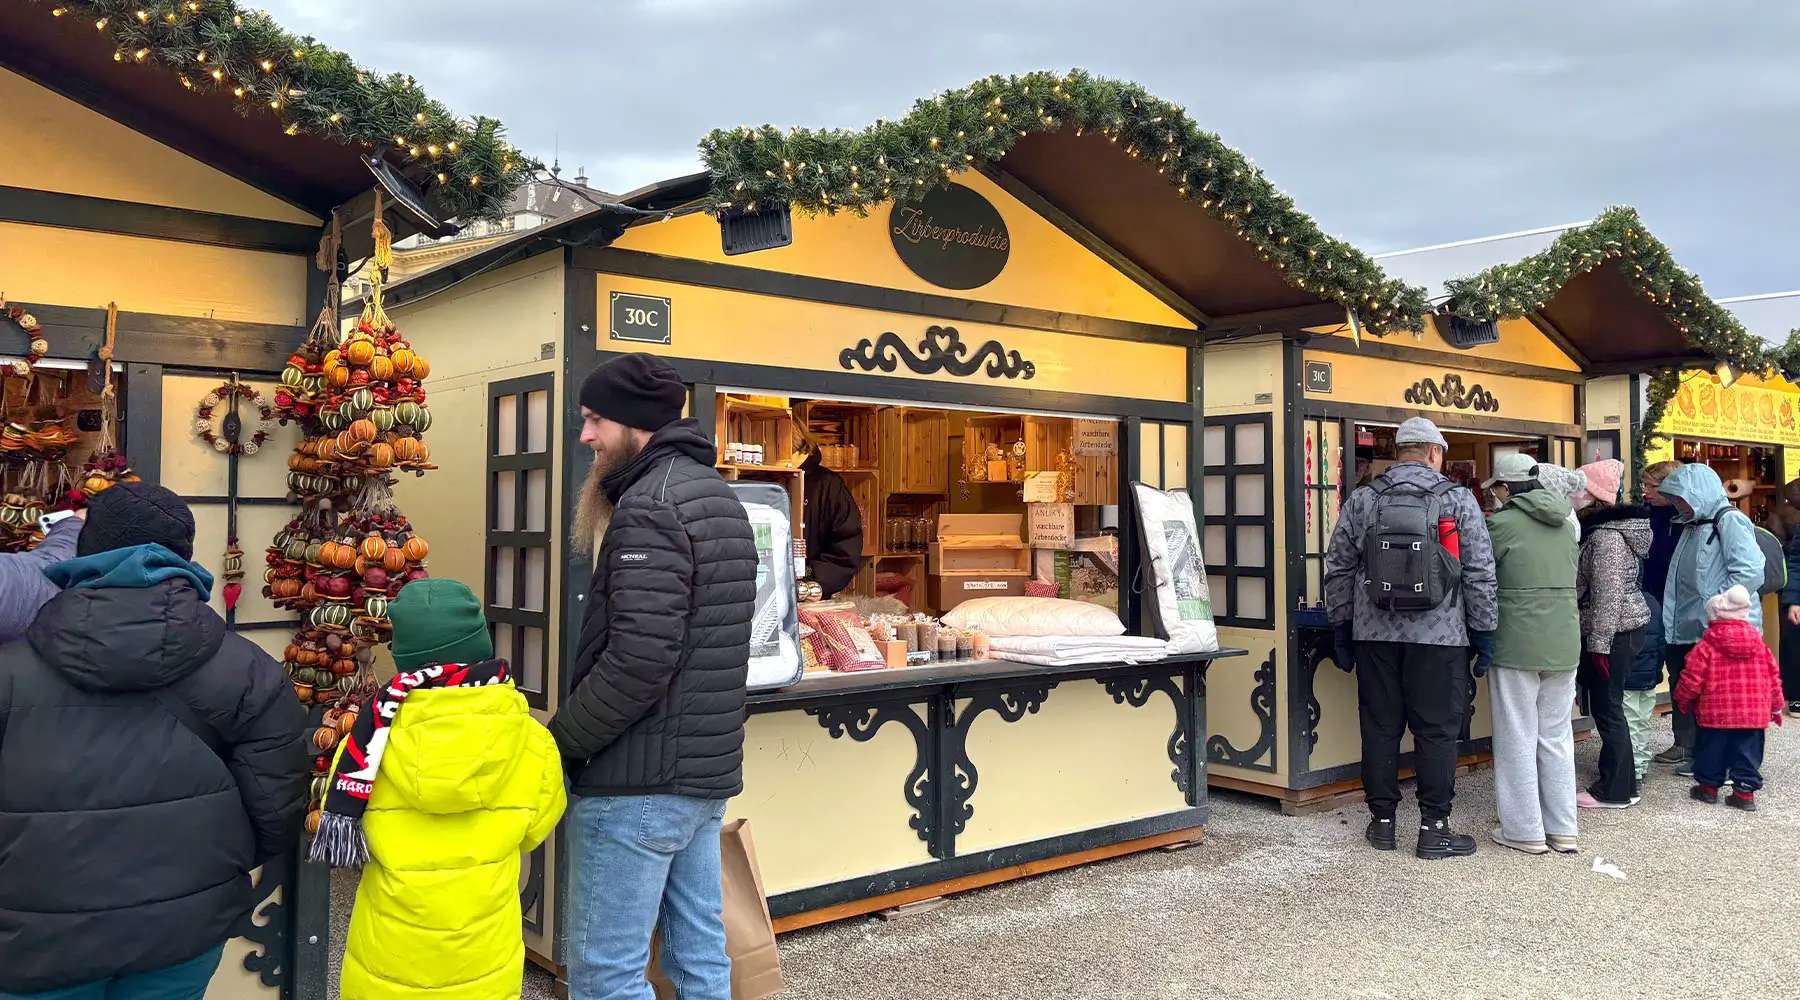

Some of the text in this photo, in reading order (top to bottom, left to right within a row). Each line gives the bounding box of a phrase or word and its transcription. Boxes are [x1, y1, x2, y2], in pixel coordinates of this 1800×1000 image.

[894, 206, 1008, 251] Zirbenprodukte
[625, 307, 658, 327] 30C
[1312, 370, 1326, 382] 31C
